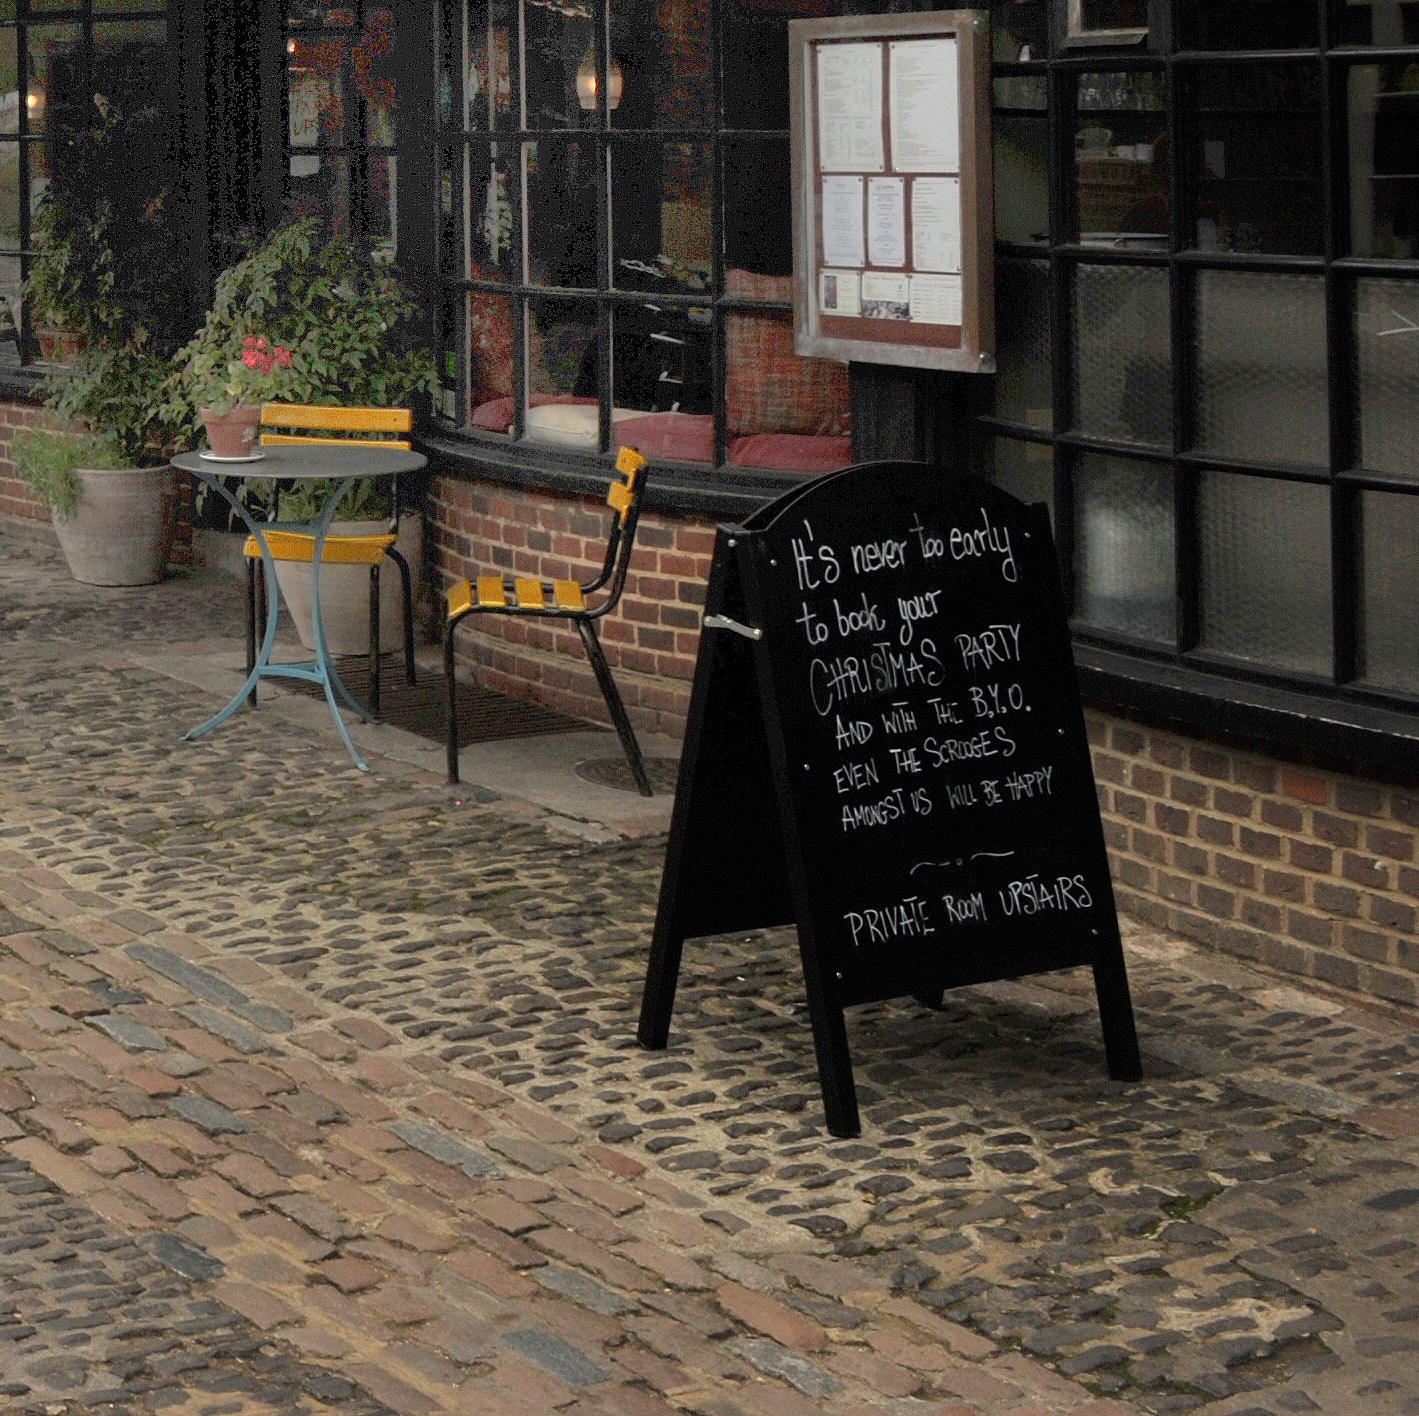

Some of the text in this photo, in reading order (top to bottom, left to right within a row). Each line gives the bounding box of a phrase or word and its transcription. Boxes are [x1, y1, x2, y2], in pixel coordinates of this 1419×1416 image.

[791, 507, 1017, 590] It's never too early
[795, 590, 942, 646] to book your
[810, 624, 1021, 716] CHRISTMAS PARTY
[835, 714, 874, 751] AND
[881, 701, 918, 734] WITH
[926, 697, 964, 725] THE
[832, 726, 1017, 794] EVEN THE SCROOGES
[841, 765, 1053, 833] AMONGST US WILL BE HAPPY
[843, 874, 1093, 946] PRIVATE ROOM UPSTAIRS
